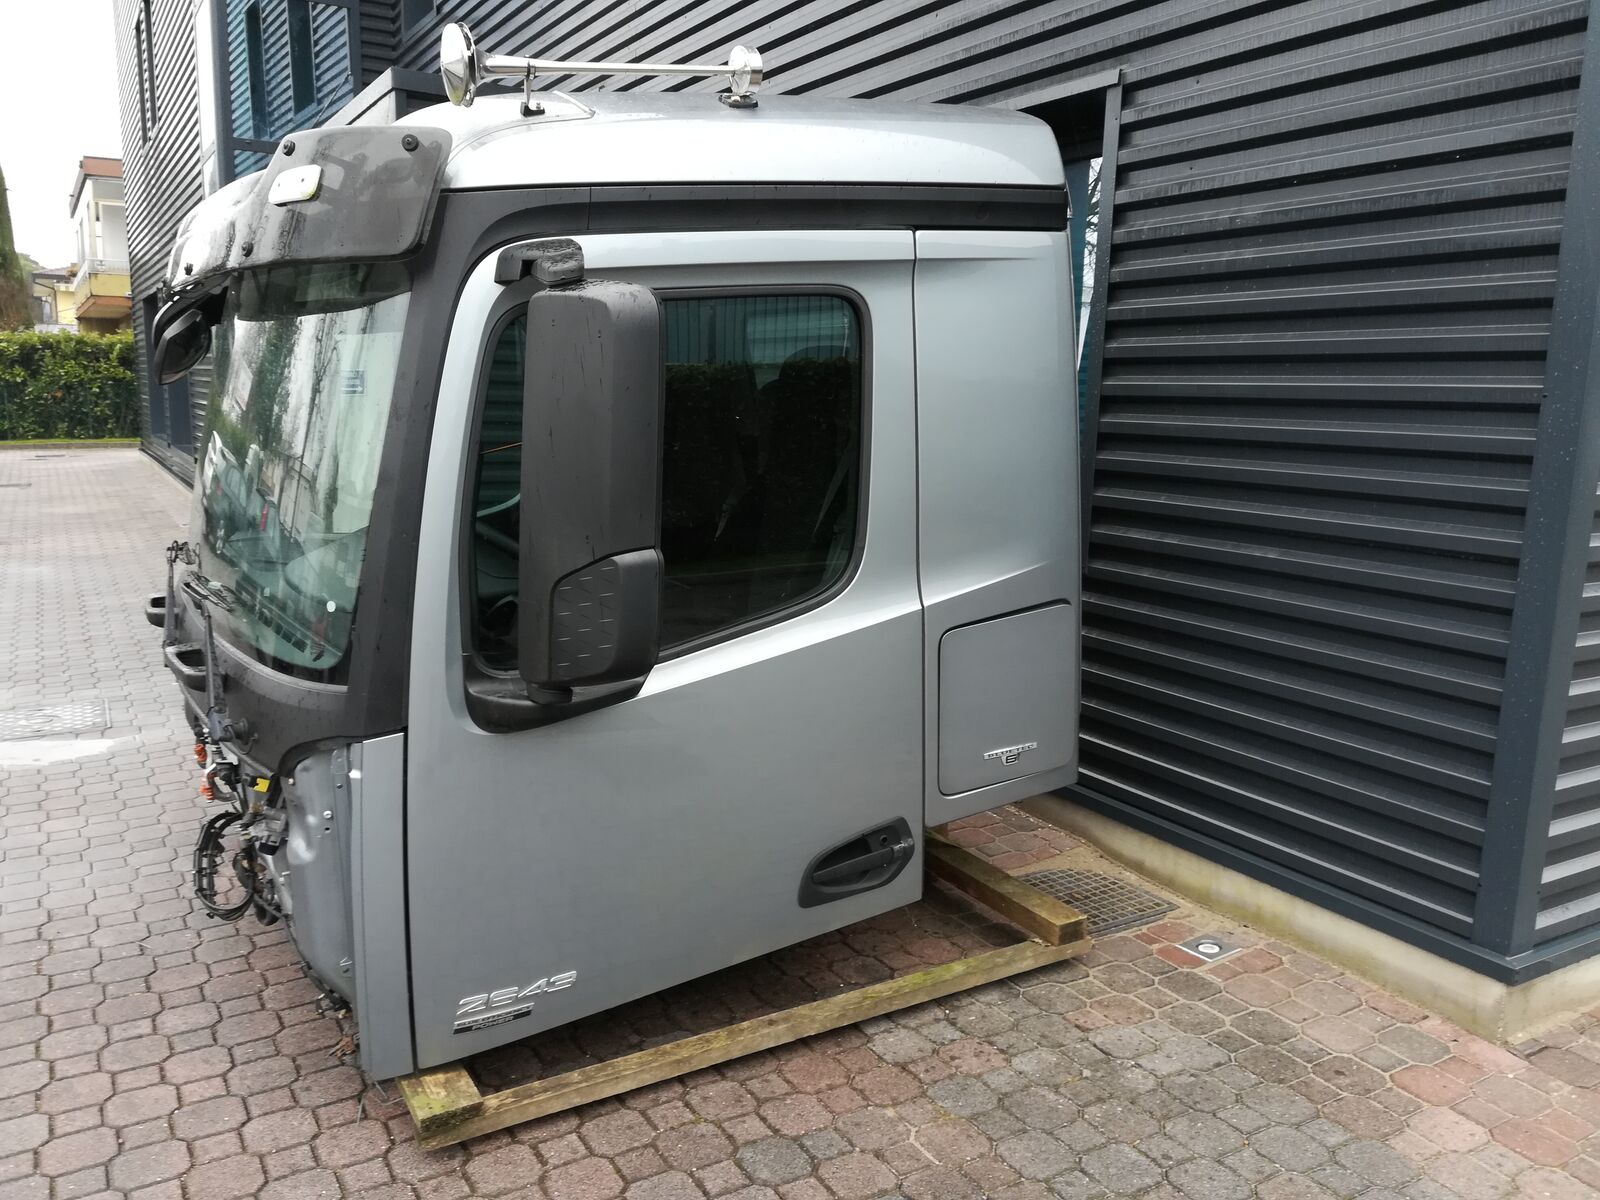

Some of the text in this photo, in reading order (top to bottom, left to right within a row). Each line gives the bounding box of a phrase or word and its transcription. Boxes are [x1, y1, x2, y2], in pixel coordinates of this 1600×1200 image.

[1005, 754, 1018, 764] 6
[456, 970, 577, 1016] 2543
[472, 1015, 514, 1031] POWER
